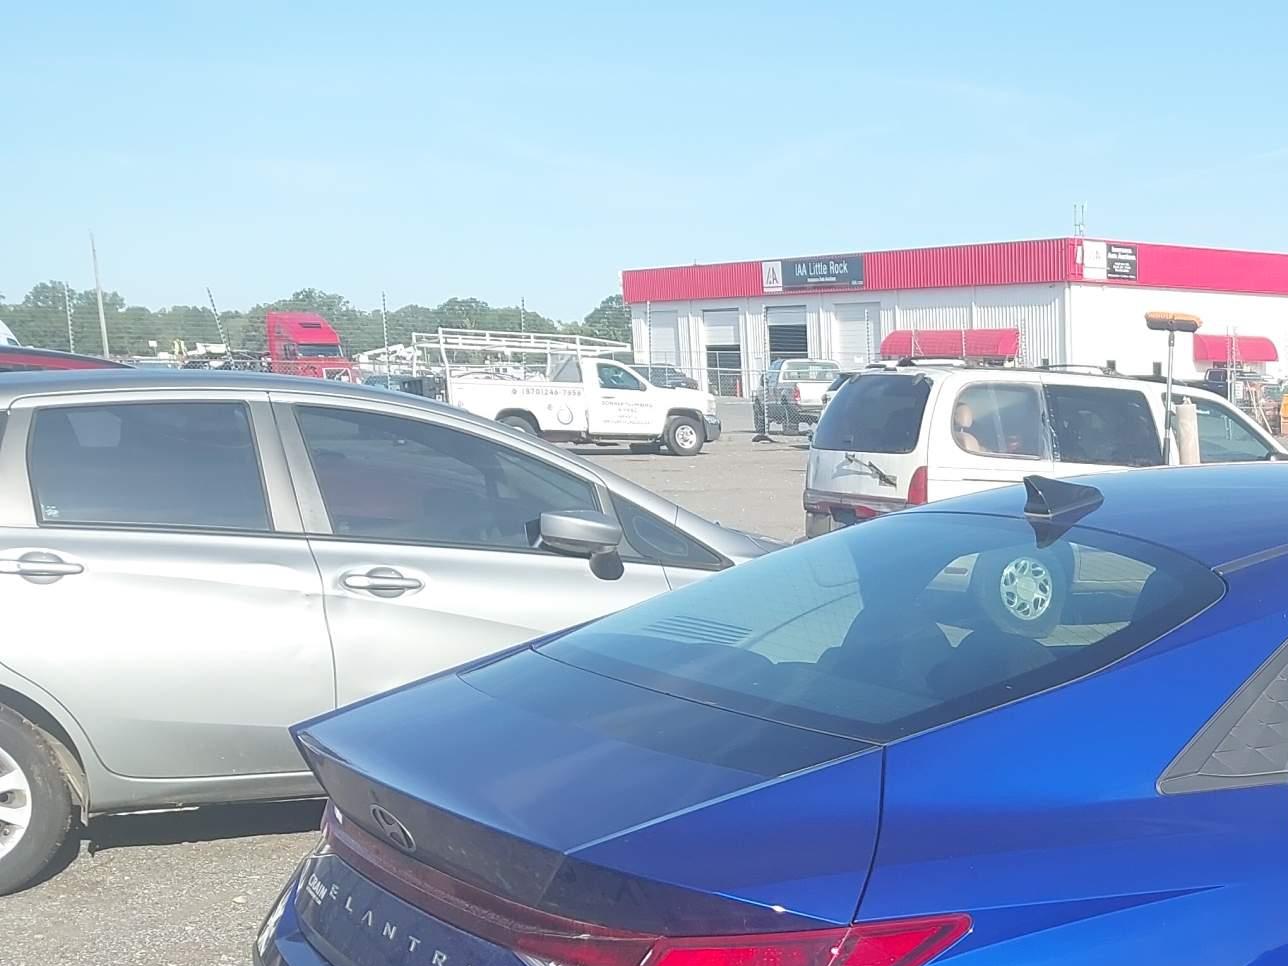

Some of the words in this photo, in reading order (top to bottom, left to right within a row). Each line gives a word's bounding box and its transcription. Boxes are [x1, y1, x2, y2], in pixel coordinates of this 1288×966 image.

[795, 263, 807, 276] IAA
[809, 262, 827, 275] Little
[829, 260, 848, 274] Rock
